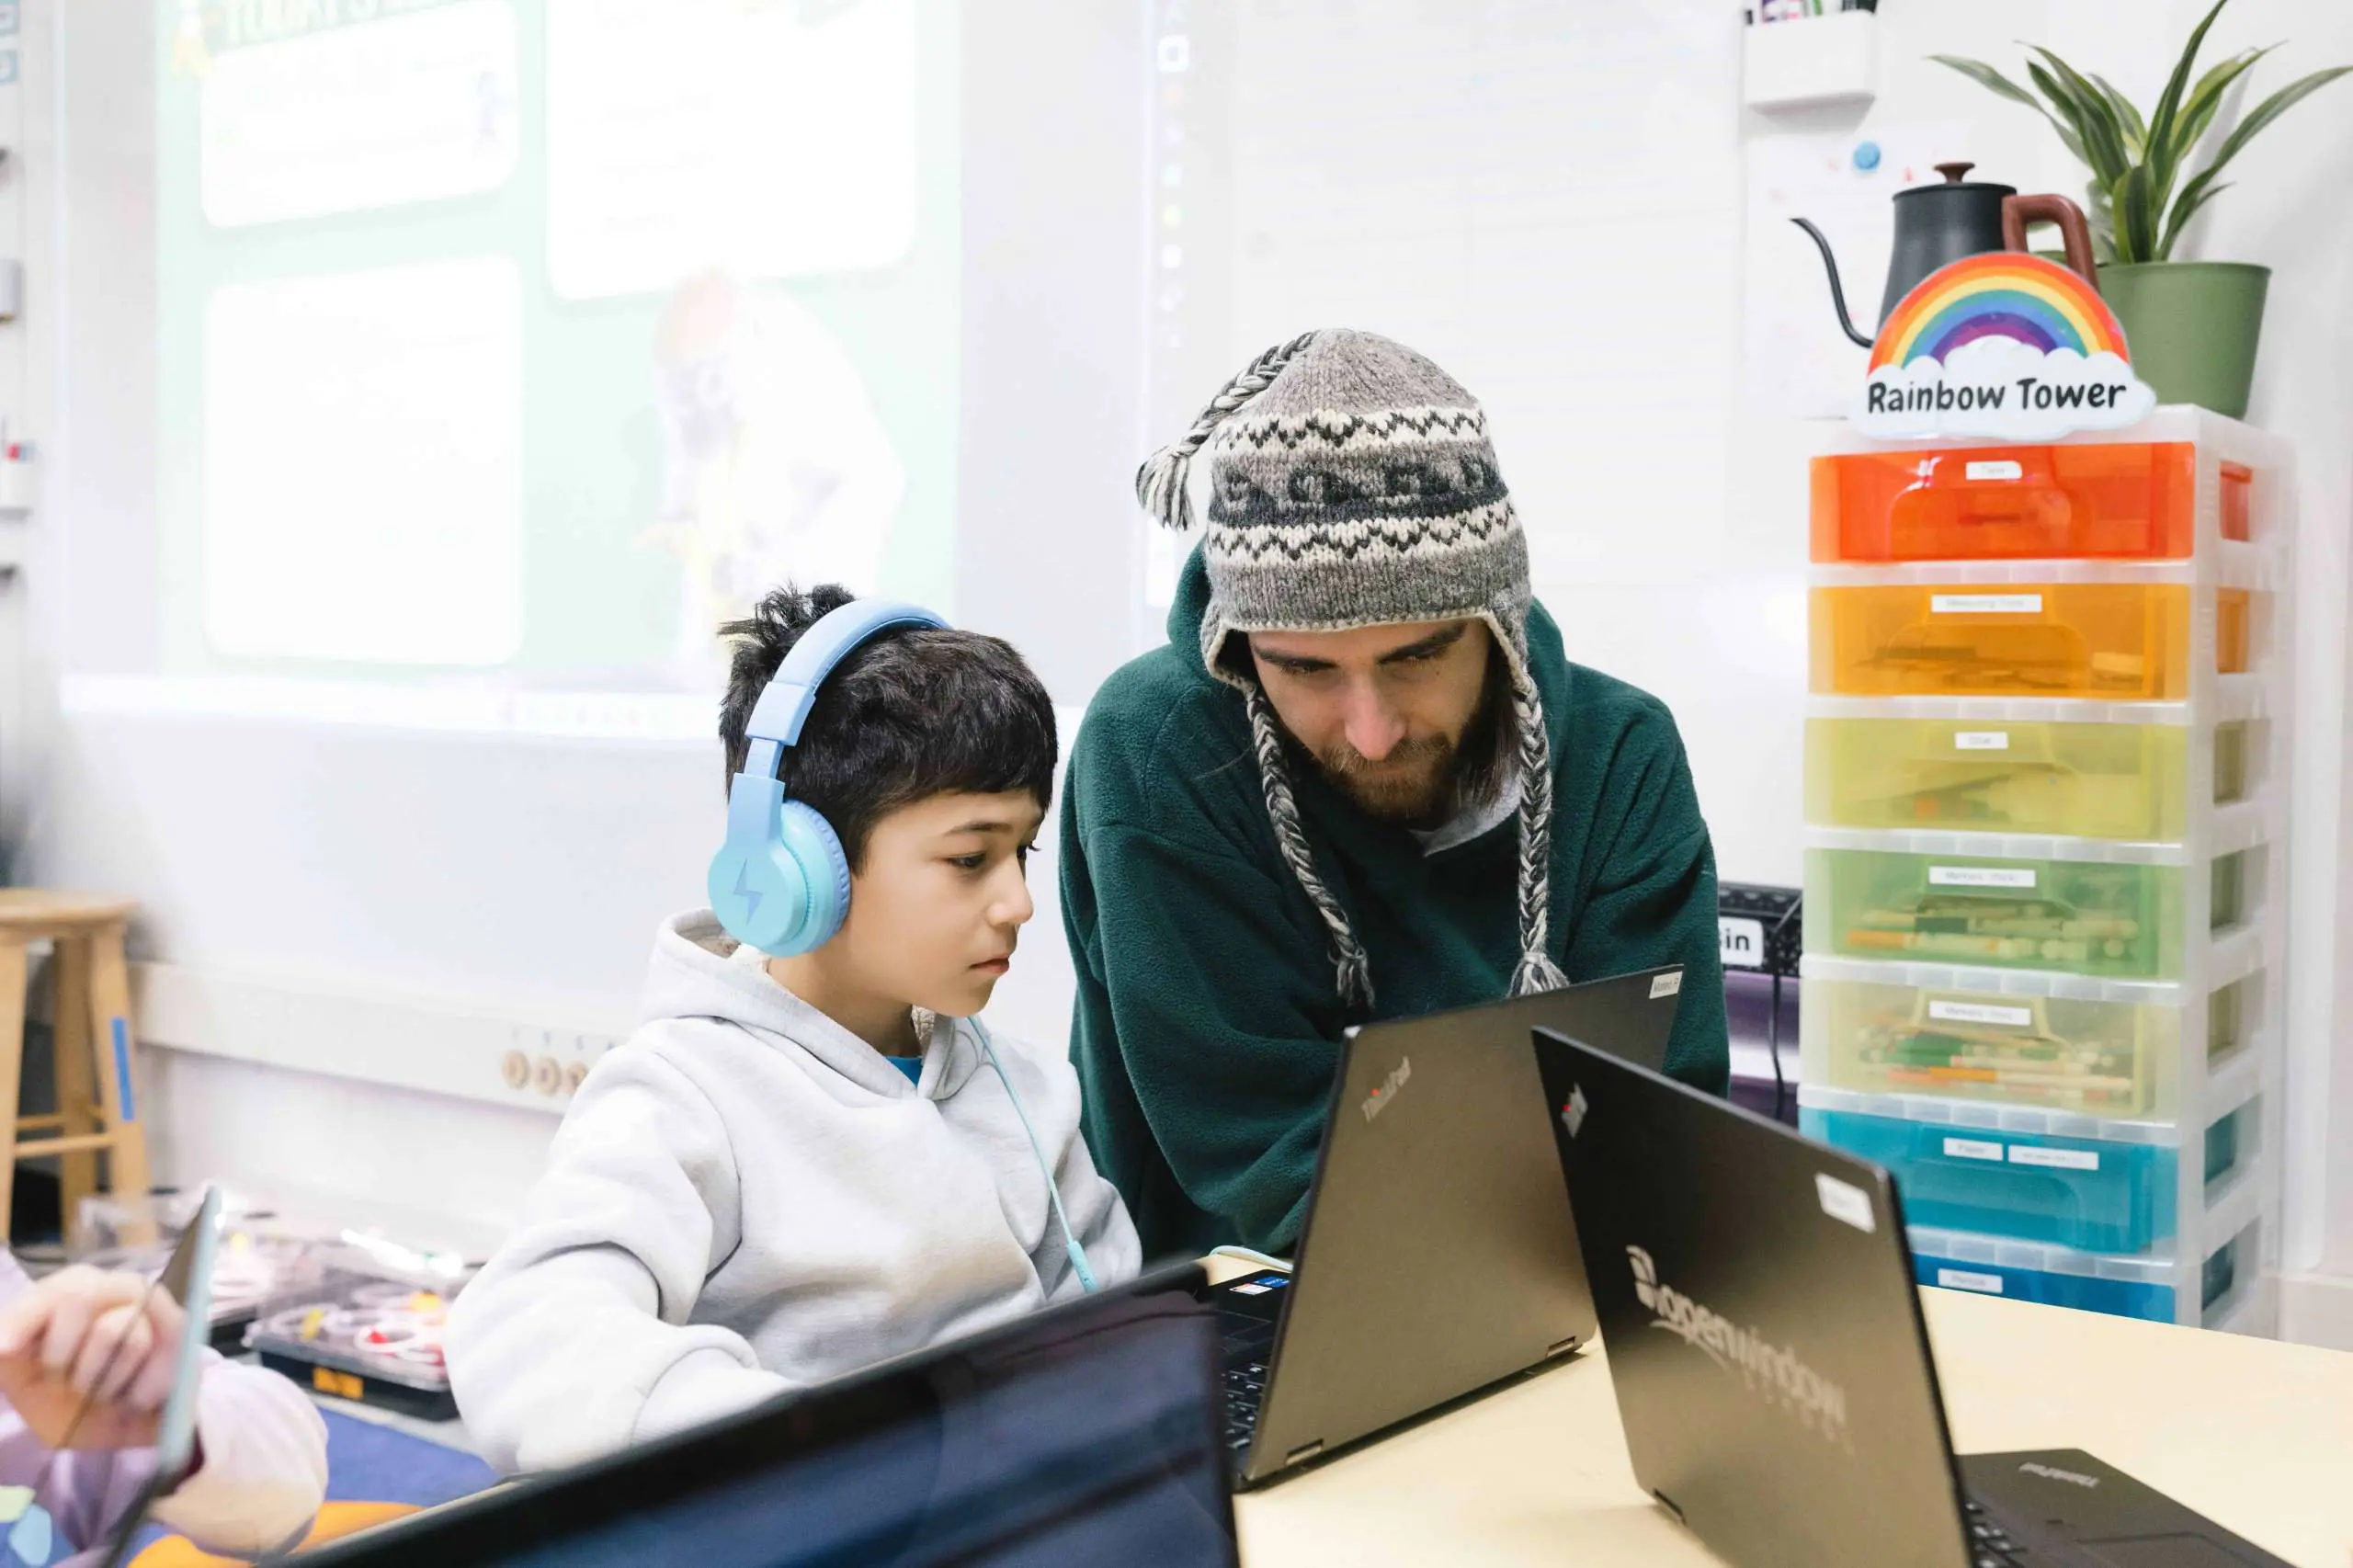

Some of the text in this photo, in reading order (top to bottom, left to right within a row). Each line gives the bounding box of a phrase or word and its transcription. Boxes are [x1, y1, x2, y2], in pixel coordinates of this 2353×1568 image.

[1868, 378, 2128, 414] Rainbow Tower
[1719, 926, 1750, 951] in
